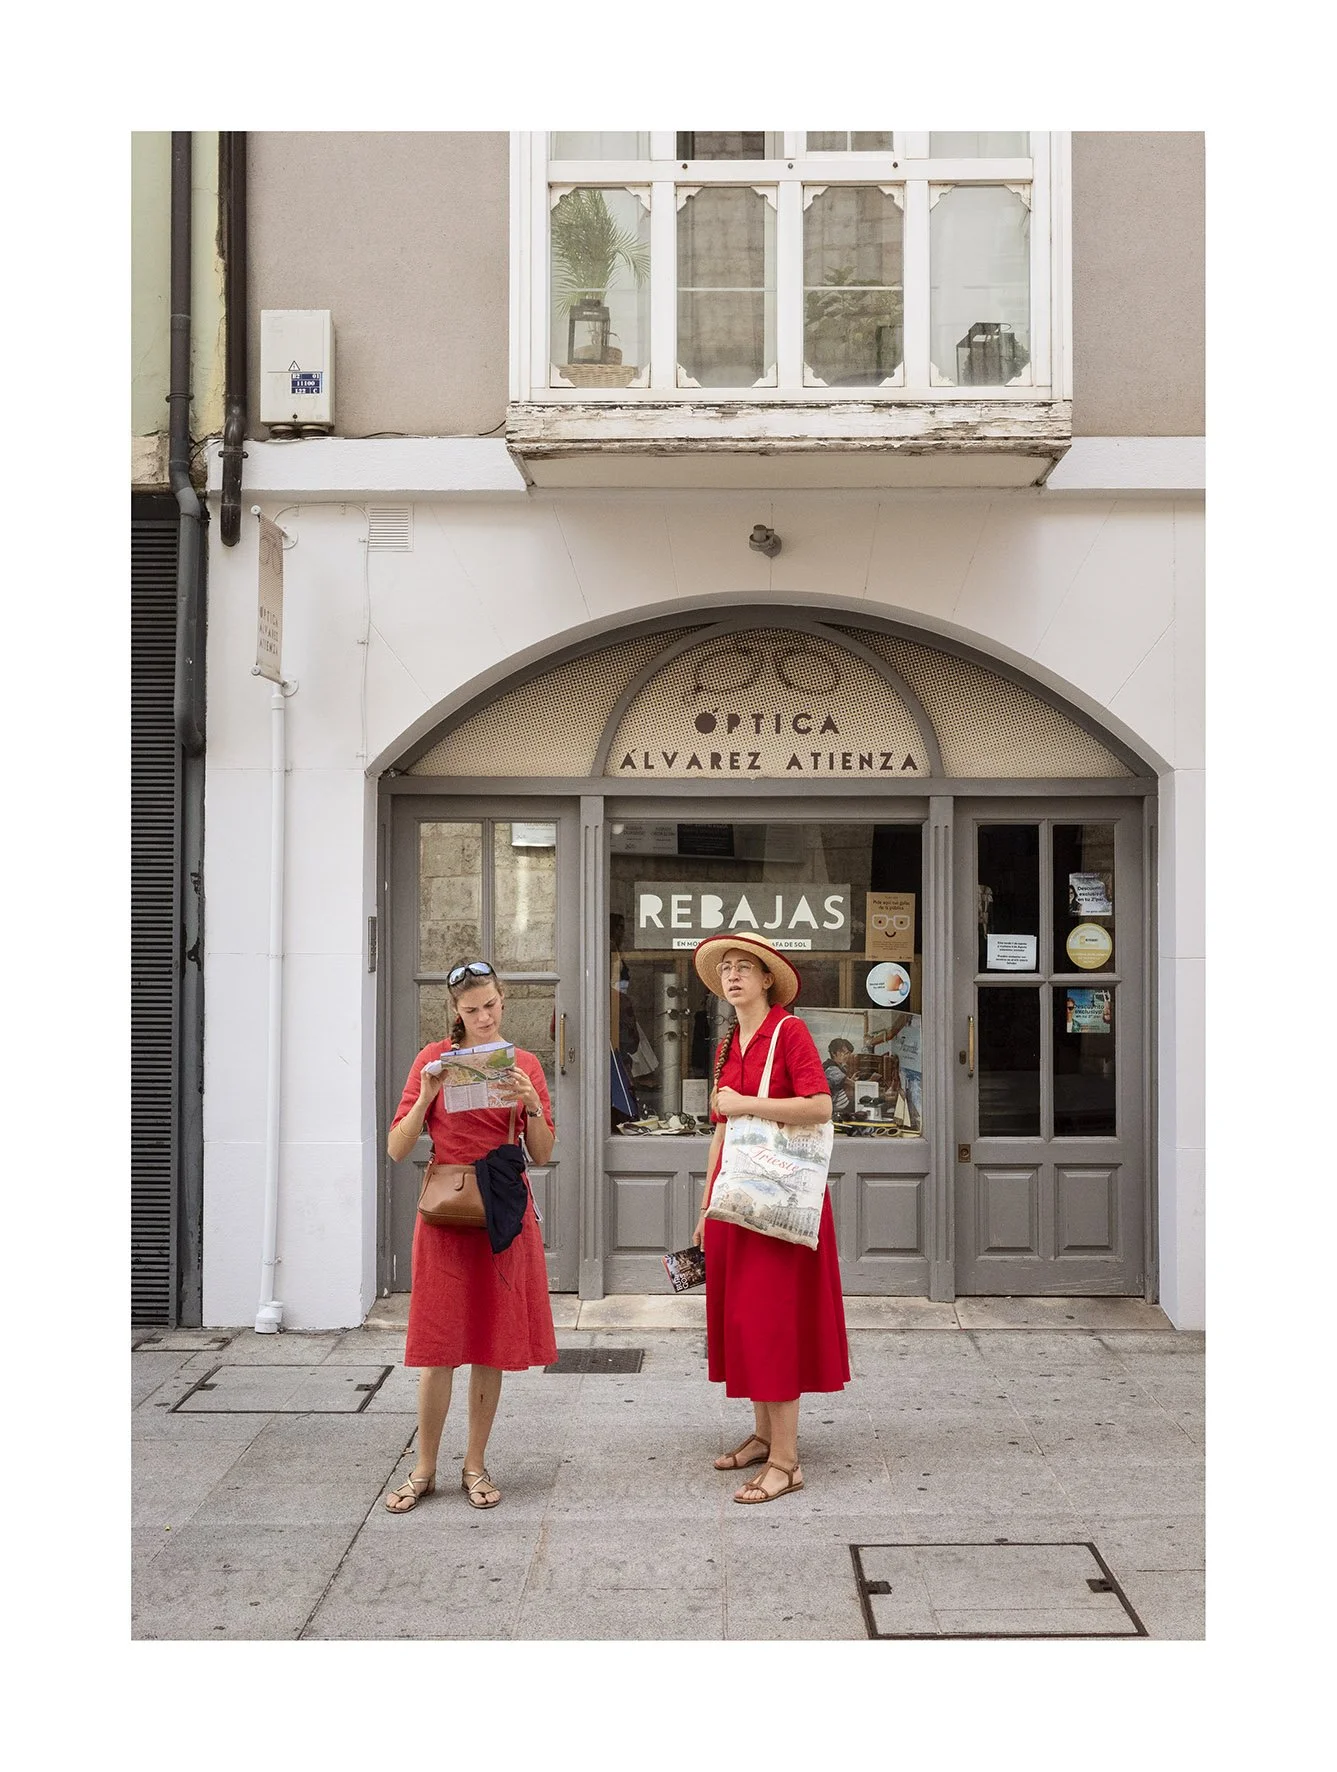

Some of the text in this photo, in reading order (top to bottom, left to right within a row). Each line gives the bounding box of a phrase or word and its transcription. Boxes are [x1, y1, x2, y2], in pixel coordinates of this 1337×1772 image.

[694, 708, 840, 735] ÓPTICA
[620, 749, 918, 771] ÁLVAREZ ATIENZA
[639, 894, 846, 930] REBAJAS
[750, 1144, 800, 1172] Trieste
